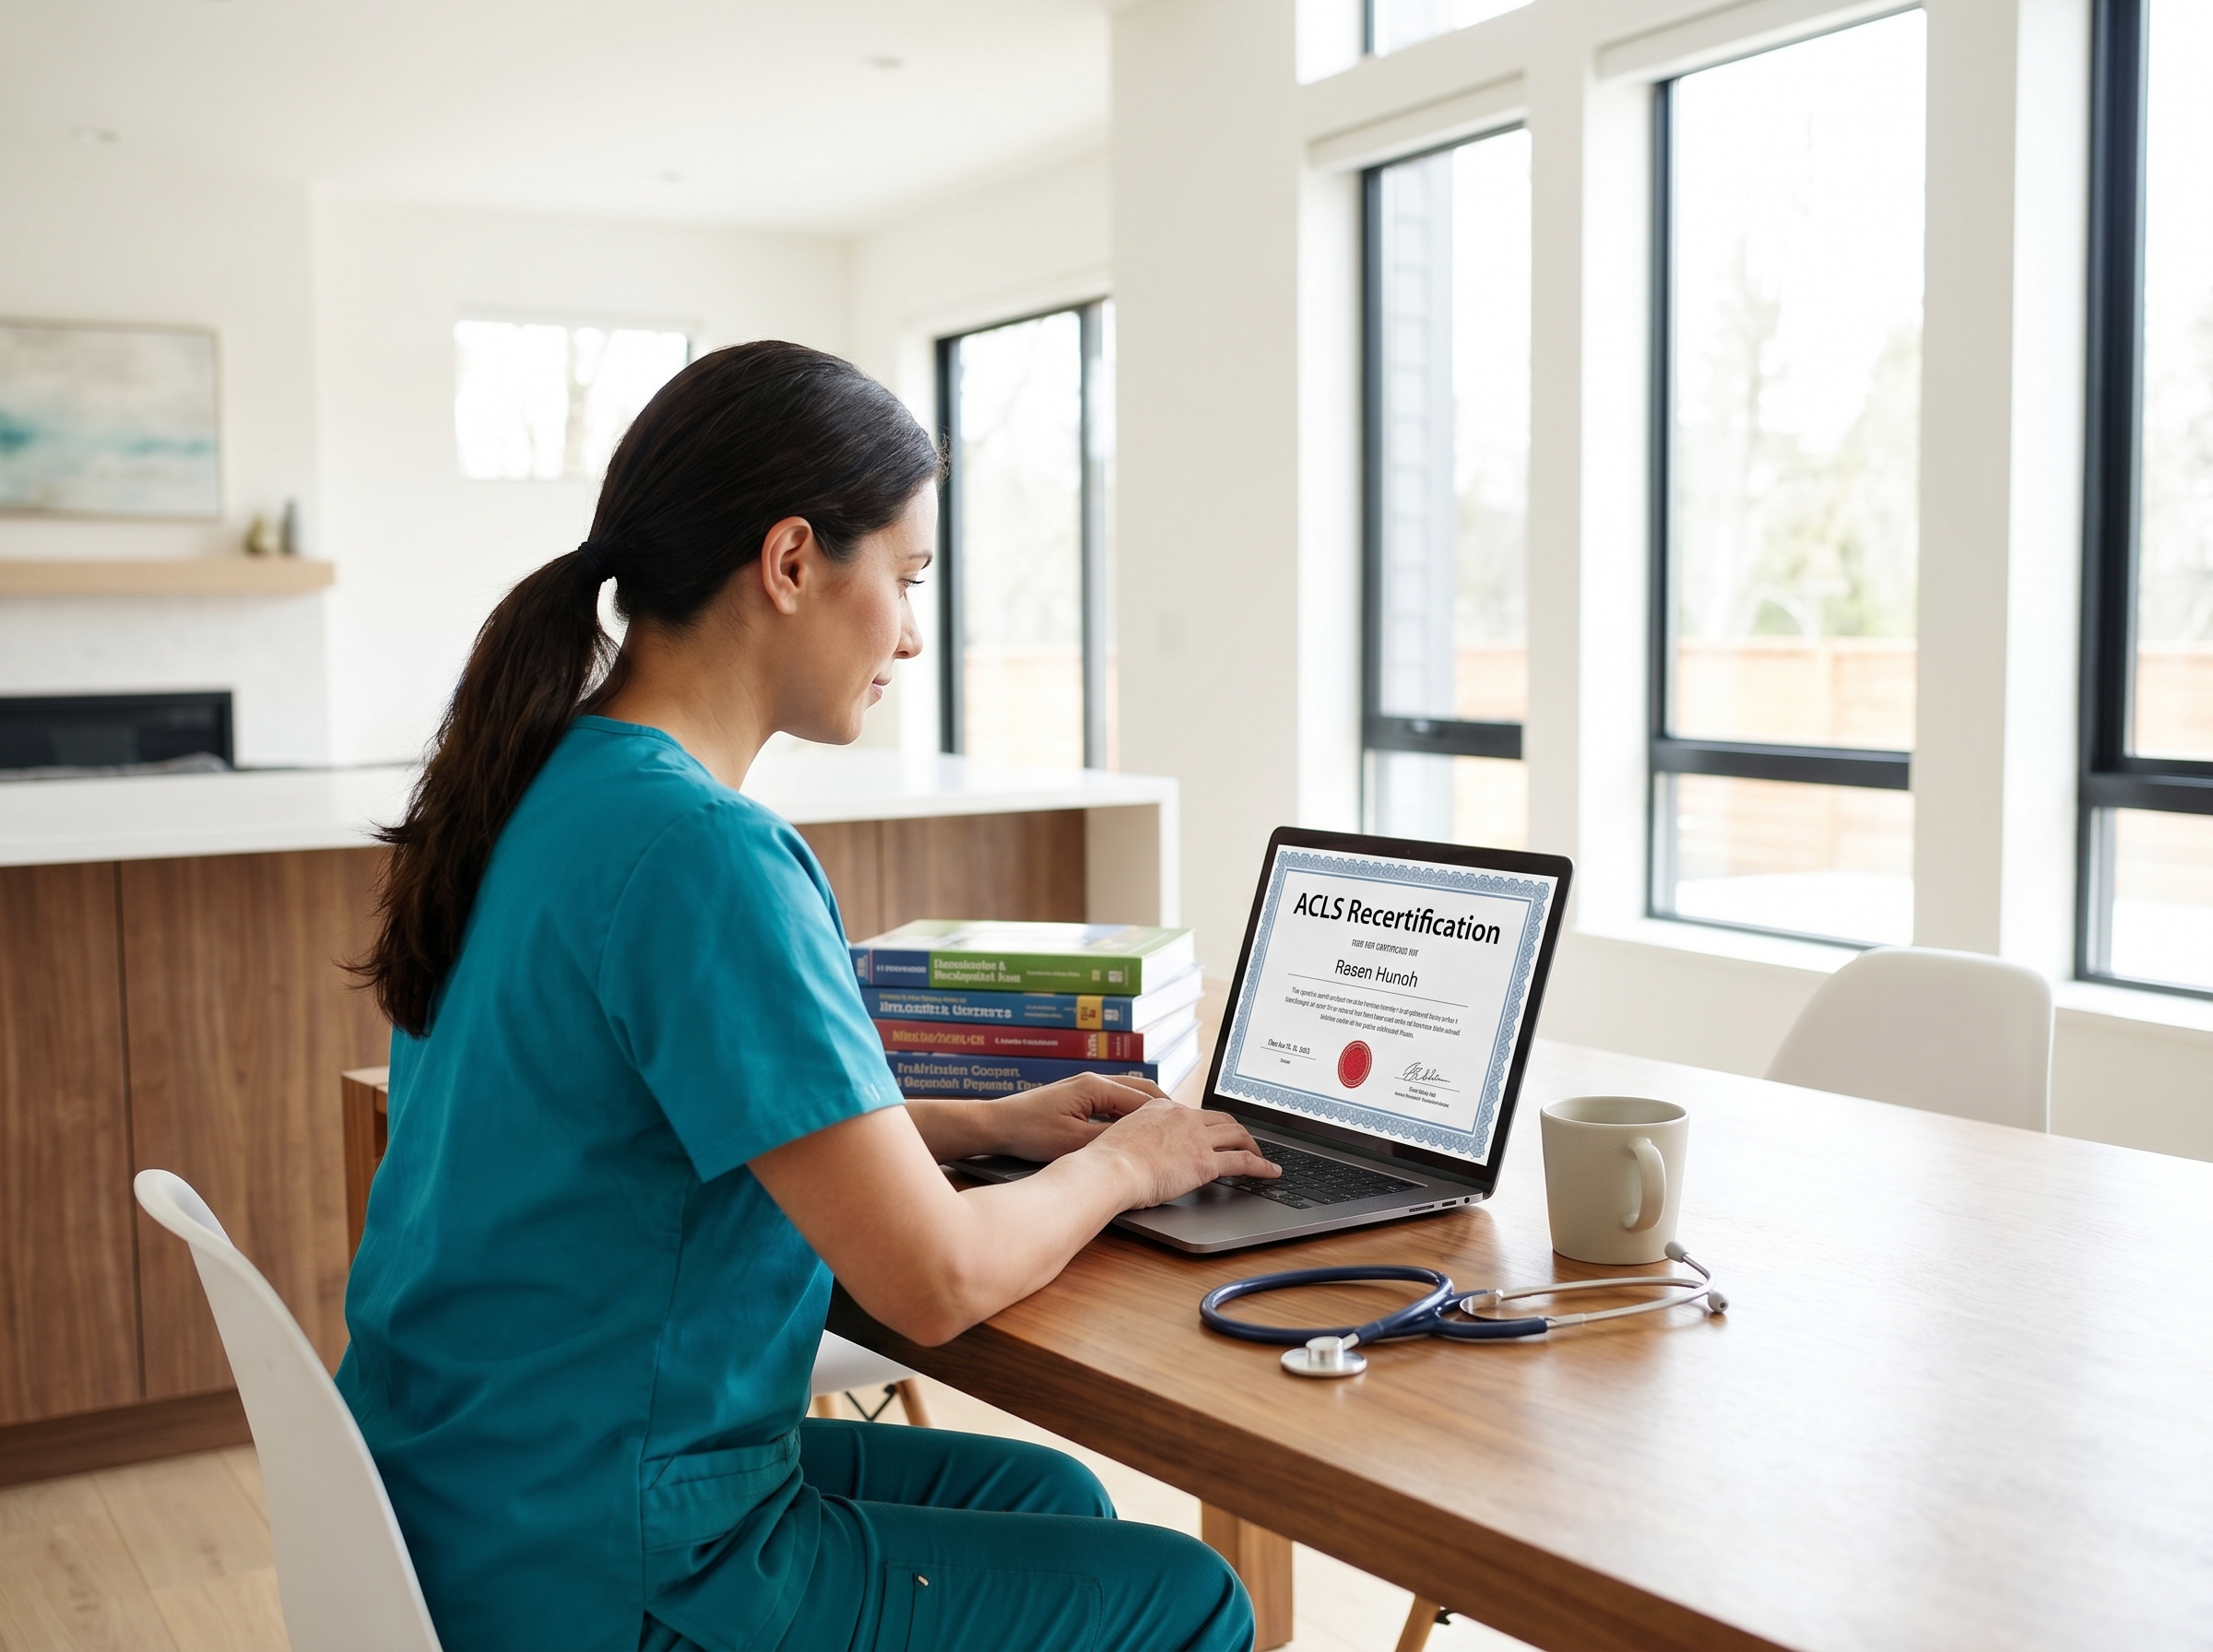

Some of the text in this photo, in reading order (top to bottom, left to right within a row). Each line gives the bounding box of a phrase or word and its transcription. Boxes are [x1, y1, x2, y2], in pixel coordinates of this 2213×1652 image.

[1294, 892, 1501, 945] ACLS Recertification
[1334, 959, 1418, 988] Rasen Hunoh
